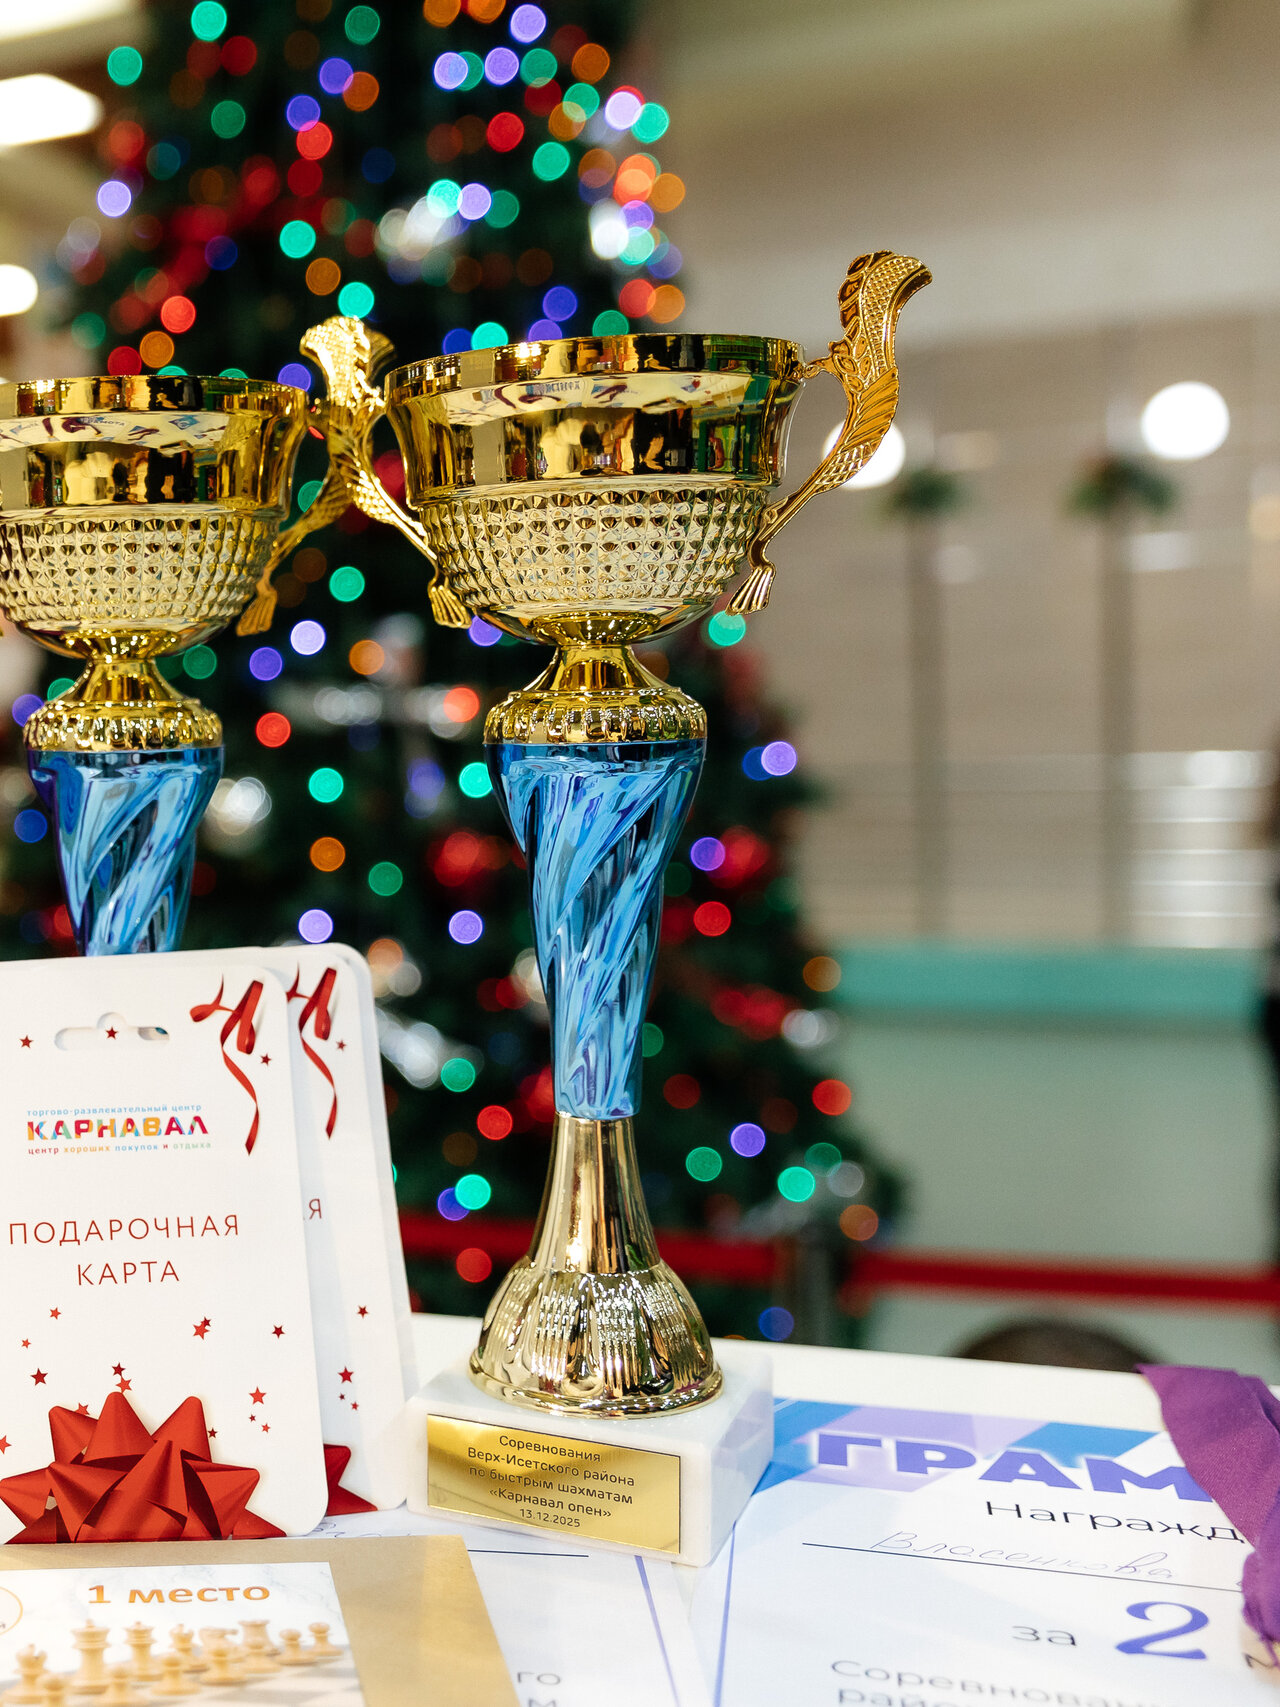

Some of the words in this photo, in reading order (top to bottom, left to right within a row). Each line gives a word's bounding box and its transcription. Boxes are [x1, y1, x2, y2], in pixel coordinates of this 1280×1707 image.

[27, 1104, 168, 1117] торгово-развлекательный
[171, 1103, 202, 1113] центр
[27, 1115, 209, 1141] КАРНАВАЛ
[28, 1146, 59, 1155] центр
[63, 1145, 111, 1155] хороших
[115, 1143, 158, 1152] покупок
[173, 1141, 212, 1150] отдыха
[8, 1214, 239, 1246] ПОДАРОЧНАЯ
[77, 1260, 180, 1287] КАРТА
[499, 1435, 600, 1462] Соревнования
[468, 1447, 579, 1477] Верх-Исетского
[583, 1468, 635, 1487] района
[817, 1432, 1214, 1503] ГРАМ
[469, 1466, 486, 1478] по
[489, 1467, 554, 1491] быстрым
[557, 1481, 633, 1505] шахматам
[489, 1487, 565, 1511] «Карнавал
[568, 1501, 612, 1518] опен»
[519, 1508, 581, 1528] 13.12.2025
[985, 1500, 1245, 1544] Награжд
[88, 1583, 111, 1604] 1
[127, 1581, 271, 1605] место
[1011, 1624, 1078, 1648] за
[1115, 1600, 1210, 1661] 2
